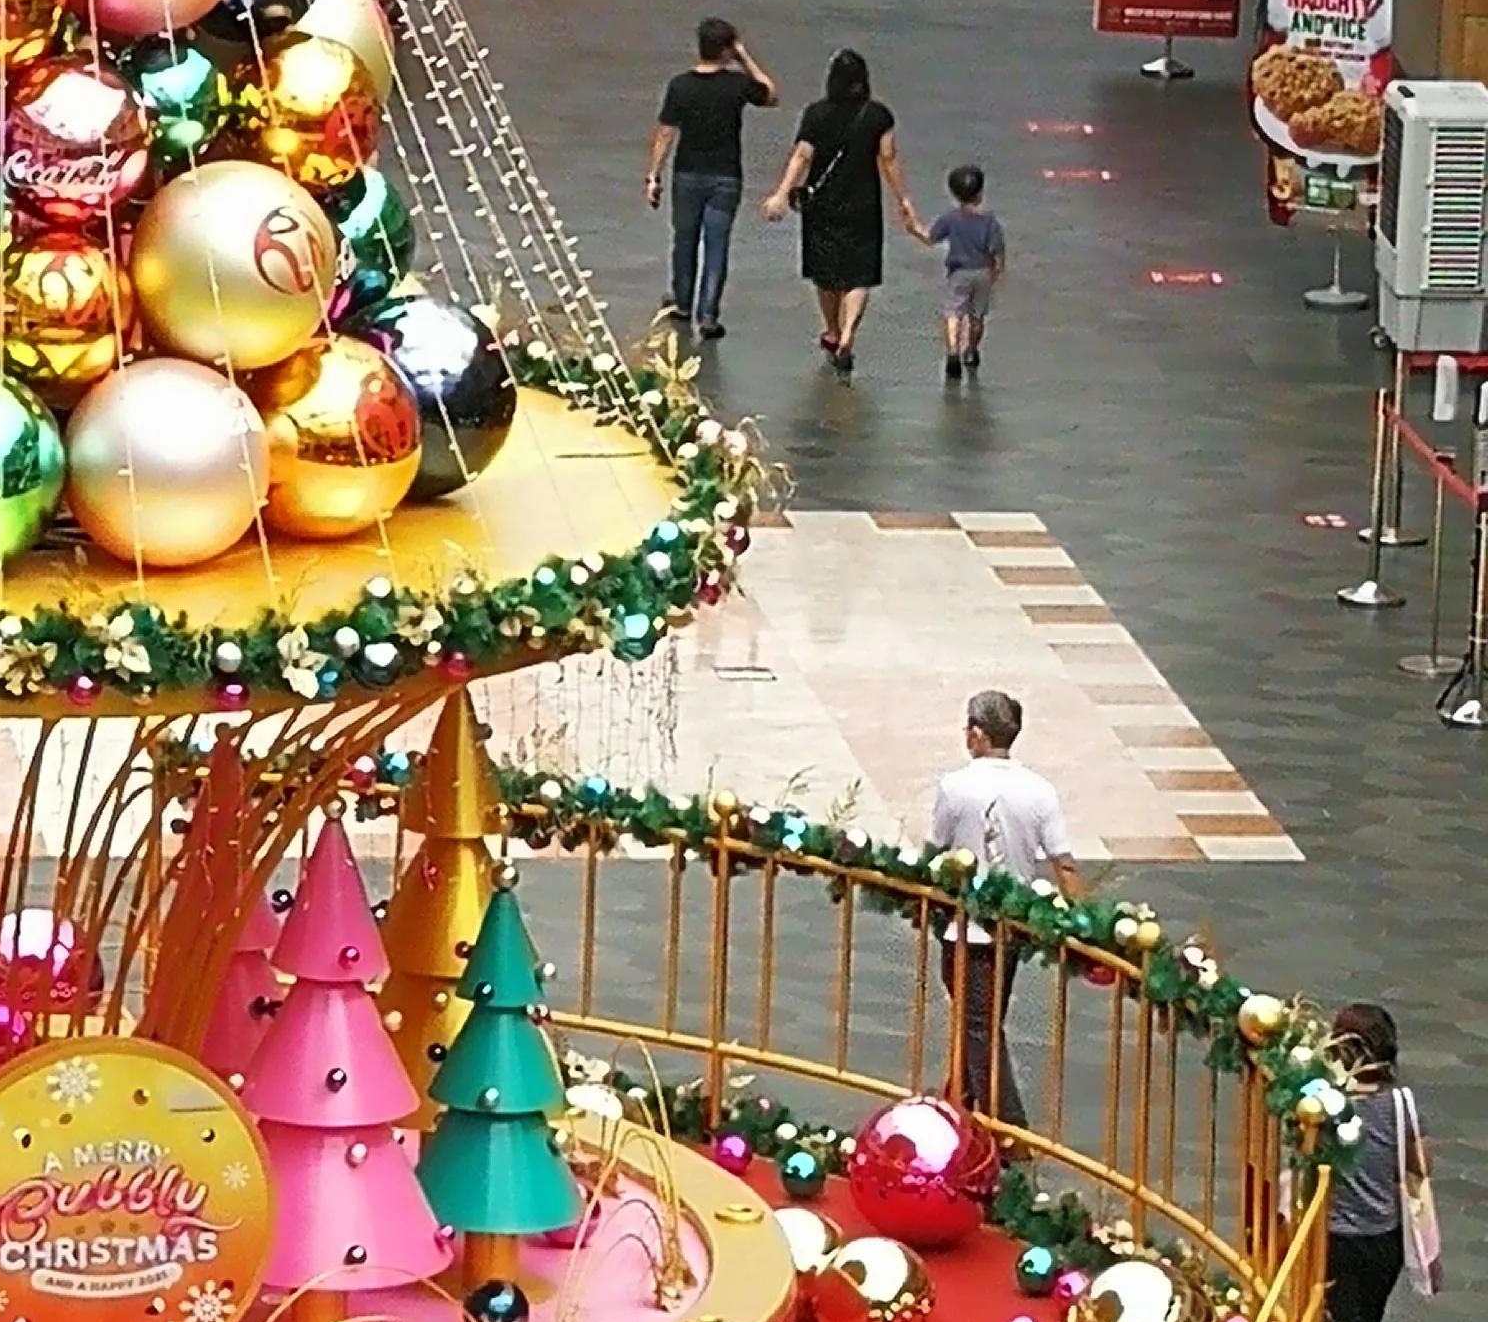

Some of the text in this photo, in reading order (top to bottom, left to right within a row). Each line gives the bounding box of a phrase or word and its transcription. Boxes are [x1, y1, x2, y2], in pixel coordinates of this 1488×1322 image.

[44, 1141, 170, 1175] A MERRY
[0, 1231, 218, 1272] CHRISTMAS
